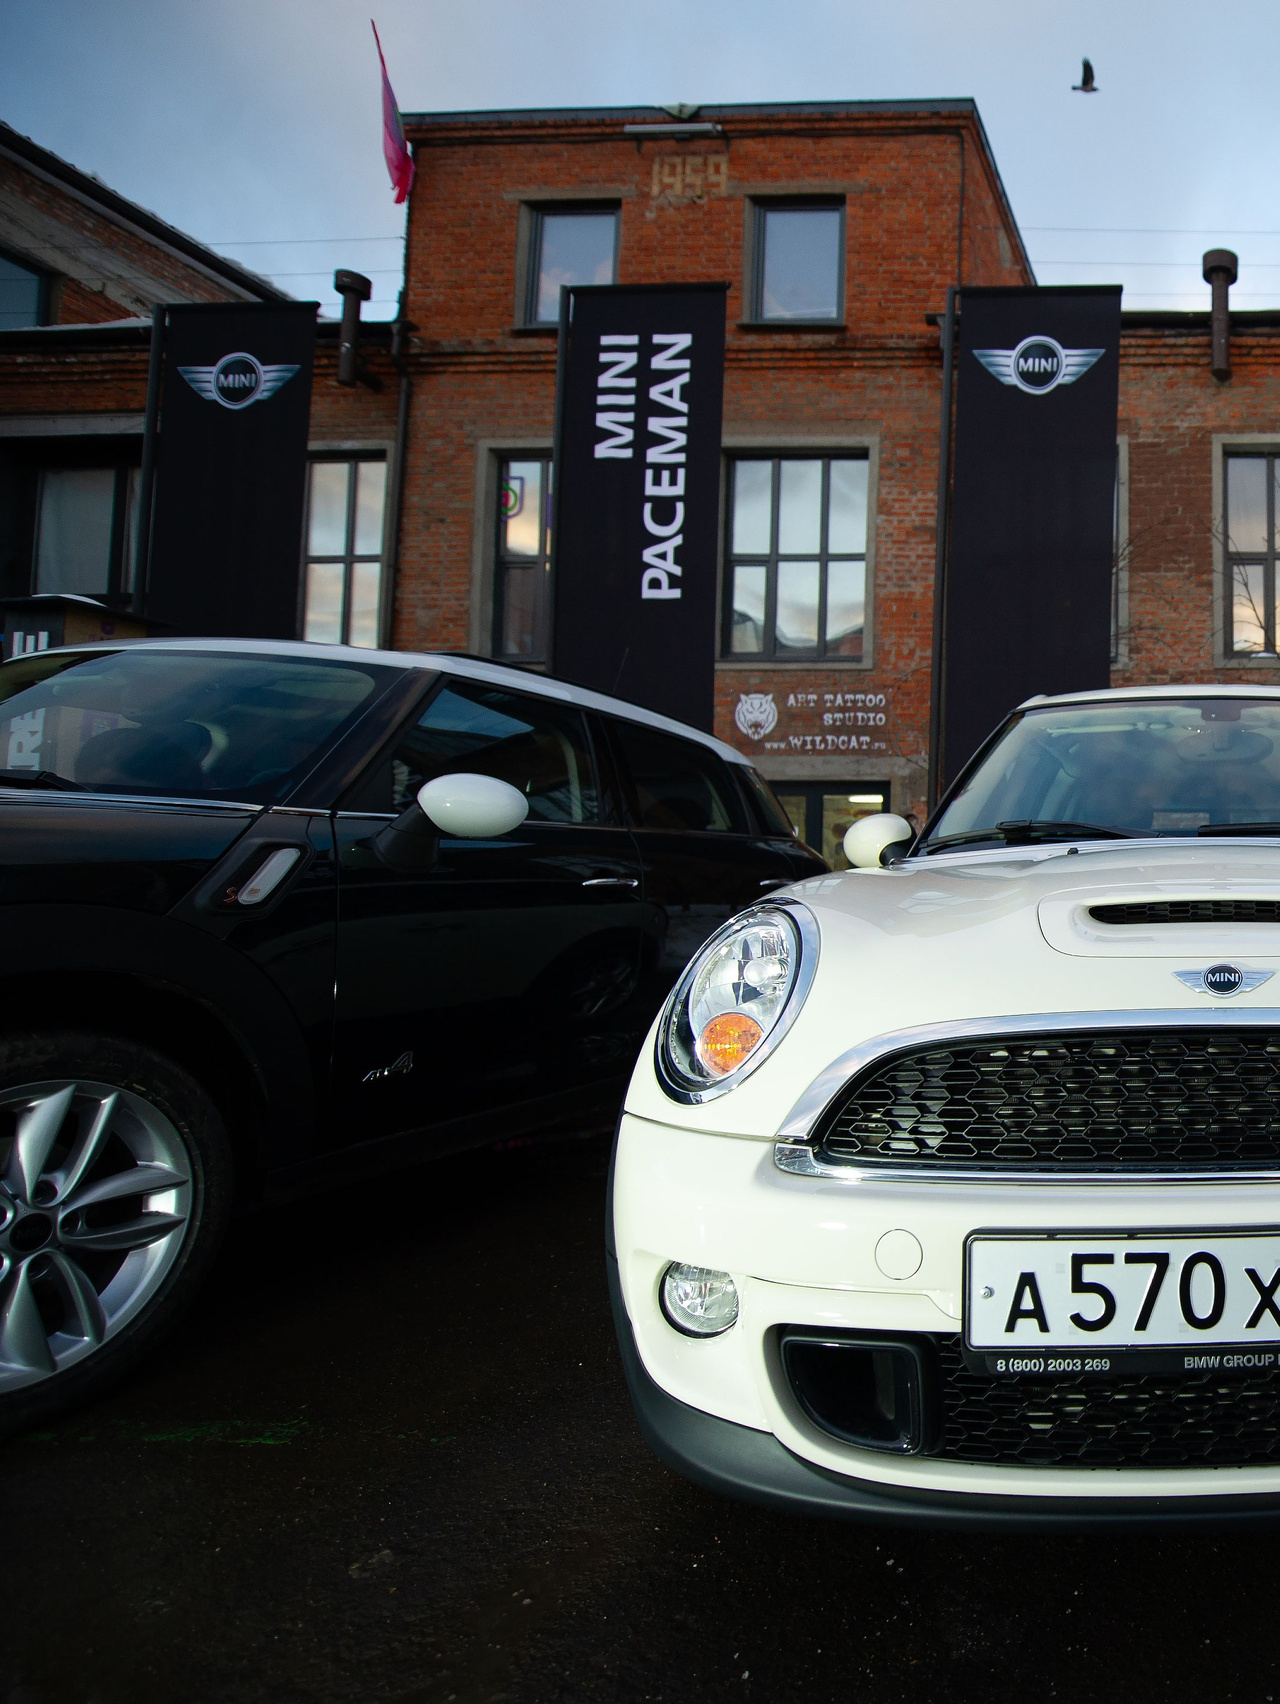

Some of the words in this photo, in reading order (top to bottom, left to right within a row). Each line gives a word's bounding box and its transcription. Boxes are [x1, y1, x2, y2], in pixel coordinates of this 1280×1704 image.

[1018, 357, 1058, 373] MINI
[217, 373, 259, 389] MINI
[594, 334, 640, 459] MINI
[641, 333, 693, 600] PACEMAN
[786, 693, 818, 708] ART
[823, 693, 886, 708] TATTOO
[822, 712, 886, 727] STUDIO
[1206, 972, 1240, 984] MINI
[996, 1359, 1006, 1372] 8
[1008, 1357, 1045, 1373] (800)
[1047, 1359, 1082, 1372] 2003
[1084, 1358, 1111, 1371] 269
[1184, 1355, 1221, 1369] BMW
[1223, 1354, 1275, 1368] GROUP
